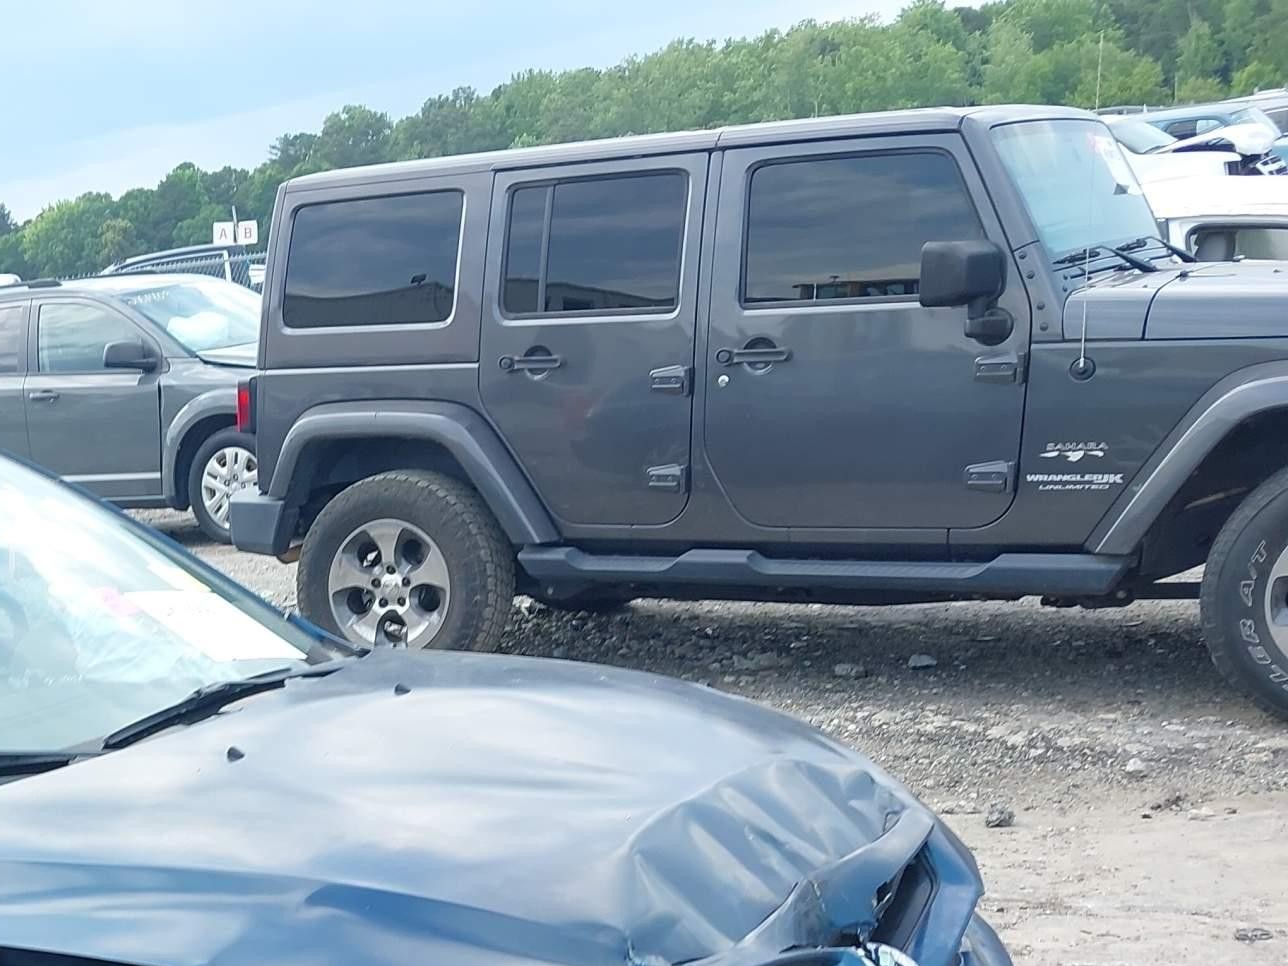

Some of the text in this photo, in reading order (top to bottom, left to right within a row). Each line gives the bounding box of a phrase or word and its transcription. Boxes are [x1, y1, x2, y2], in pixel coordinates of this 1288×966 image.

[219, 228, 228, 240] A
[244, 227, 252, 239] B
[1046, 441, 1109, 451] SAHARA
